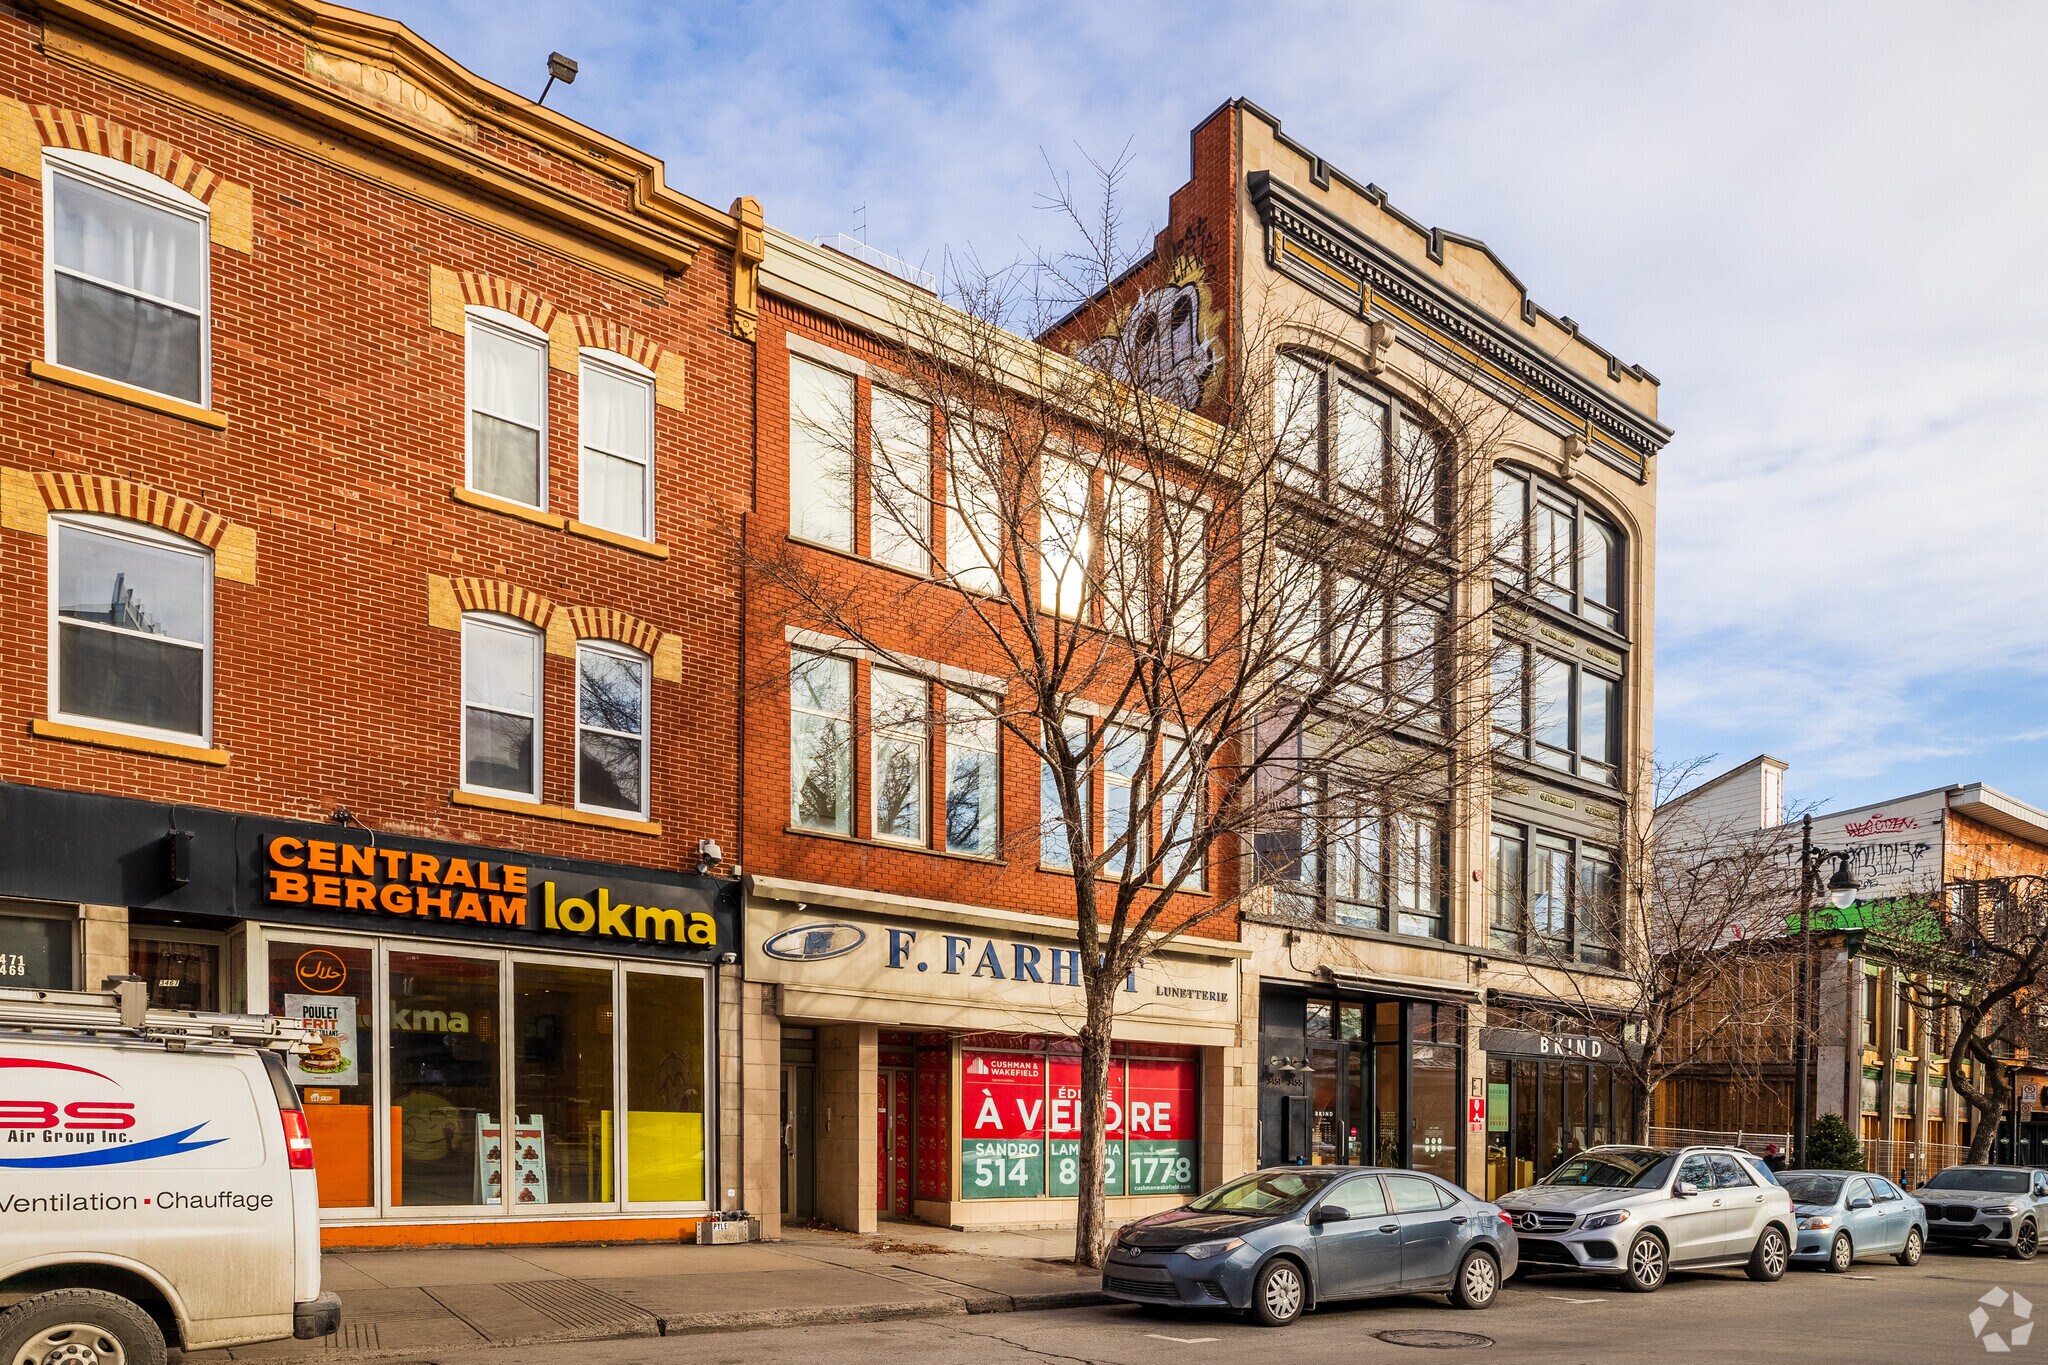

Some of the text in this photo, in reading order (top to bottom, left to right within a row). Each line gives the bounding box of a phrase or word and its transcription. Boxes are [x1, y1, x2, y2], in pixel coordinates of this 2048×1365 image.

[359, 63, 428, 112] 1910
[269, 836, 527, 894] CENTRALE
[269, 869, 527, 926] BERGHAM
[544, 881, 717, 946] lokma
[300, 960, 342, 979] حلال
[884, 927, 1143, 993] F. FARH
[1155, 985, 1229, 1003] LUNETTERIE
[303, 1006, 338, 1019] POULET
[303, 1019, 338, 1030] FRIT
[1540, 1036, 1601, 1057] BKIND
[991, 1061, 1031, 1069] CUSHMAN
[991, 1069, 1039, 1077] WAKEFIELD
[1058, 1086, 1113, 1100] ÉDIE
[974, 1088, 1171, 1132] À VEDRE
[8, 1130, 133, 1144] Air Group Inc.
[976, 1143, 1121, 1156] SANDRO LAMIA
[975, 1157, 1192, 1187] 514 82 1778
[0, 1191, 274, 1212] Ventilation Chauffage
